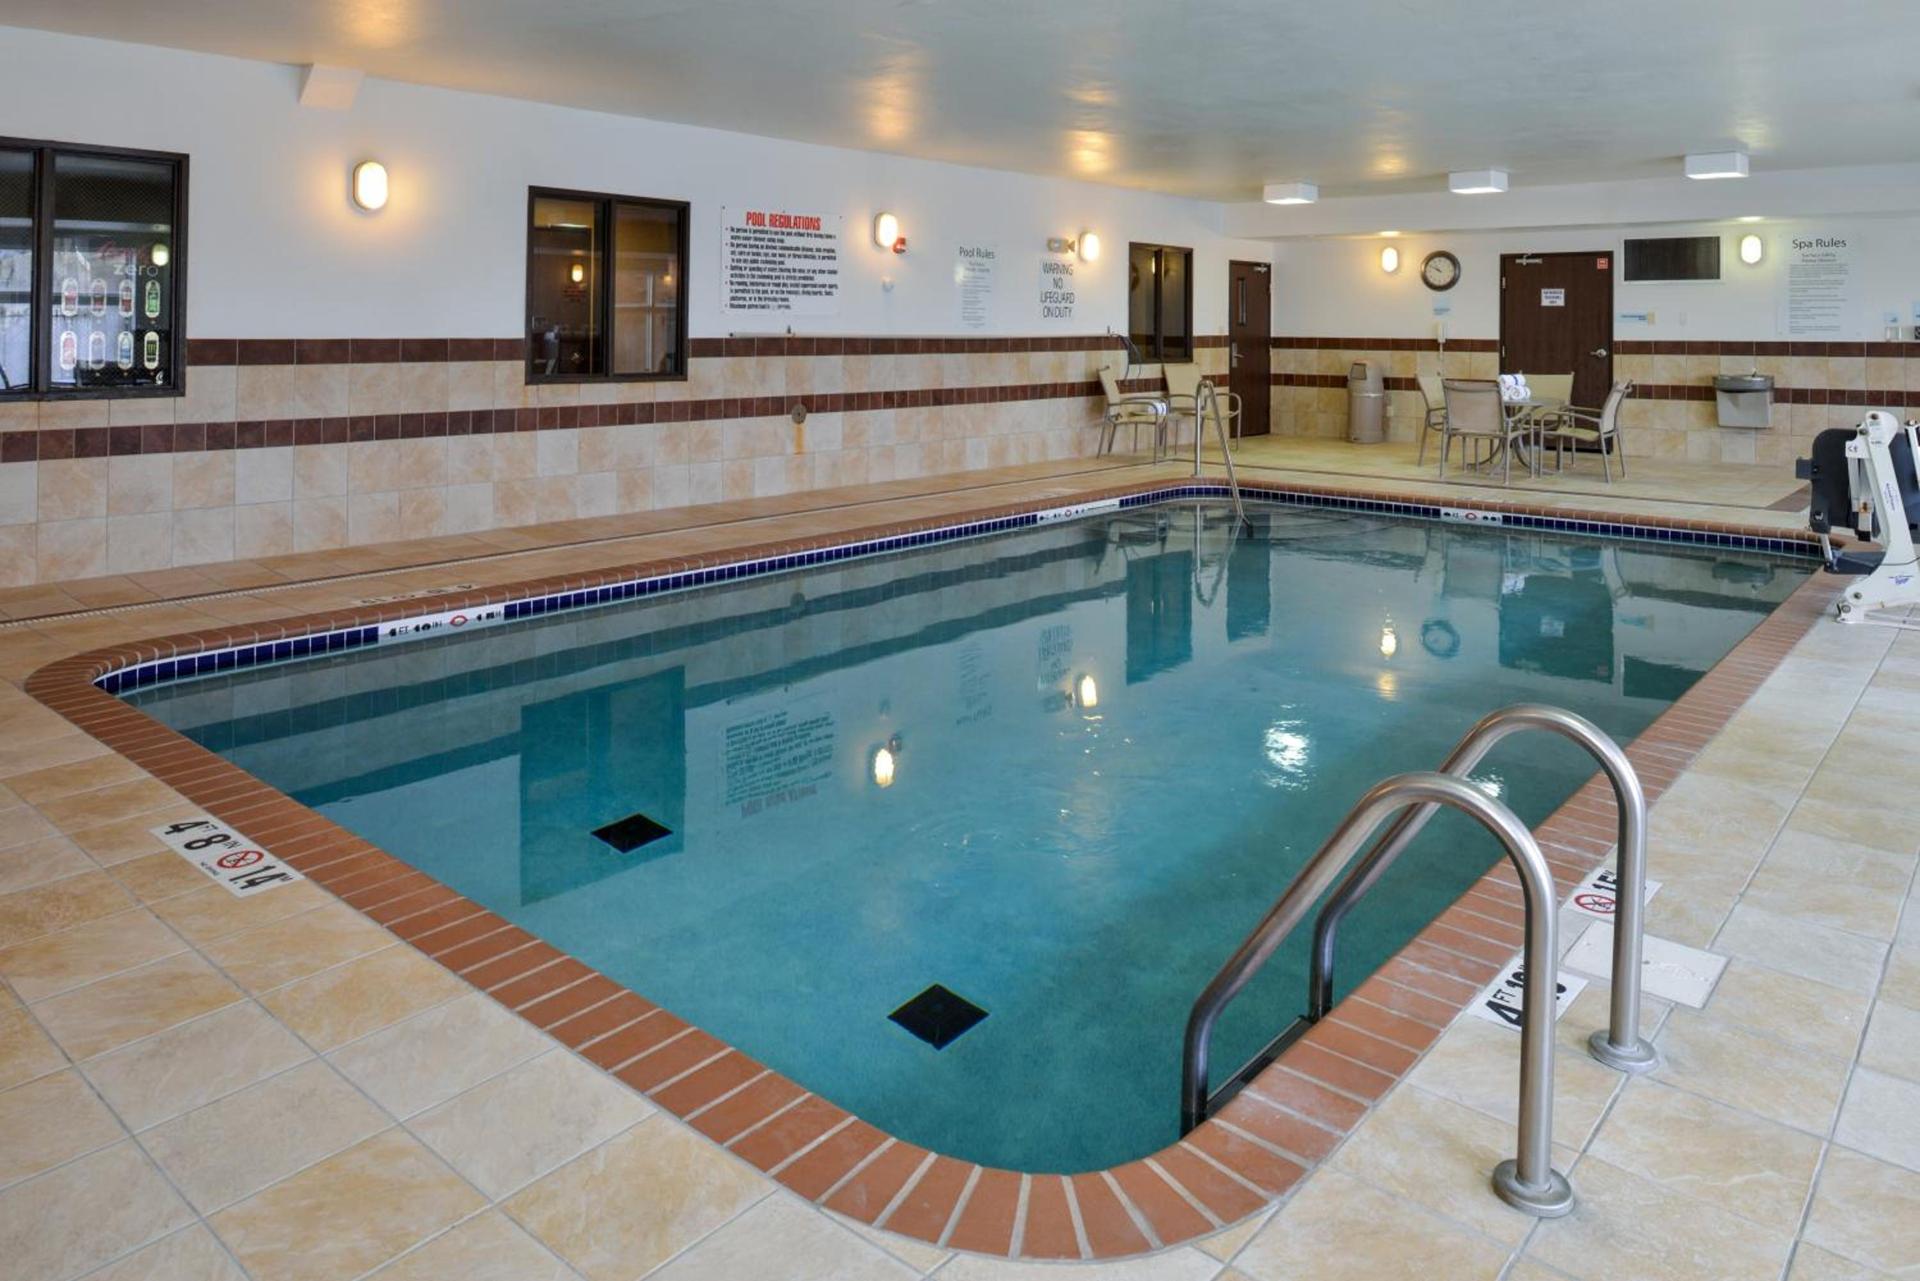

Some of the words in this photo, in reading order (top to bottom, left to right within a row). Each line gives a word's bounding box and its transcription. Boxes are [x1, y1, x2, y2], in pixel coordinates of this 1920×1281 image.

[746, 211, 766, 227] POOL
[768, 213, 821, 231] REGULATIONS
[1792, 239, 1813, 251] Spa
[1815, 238, 1847, 249] Rules
[959, 246, 974, 257] Pool
[976, 247, 995, 259] Rules
[113, 264, 158, 277] zero
[1042, 262, 1074, 276] WARNING
[1053, 277, 1064, 289] NO
[1040, 291, 1075, 304] LIFEGUARD
[1043, 306, 1054, 318] ON
[1055, 307, 1073, 318] DUTY
[164, 821, 209, 835] 4
[184, 834, 231, 850] 8
[1493, 989, 1516, 1003] FT
